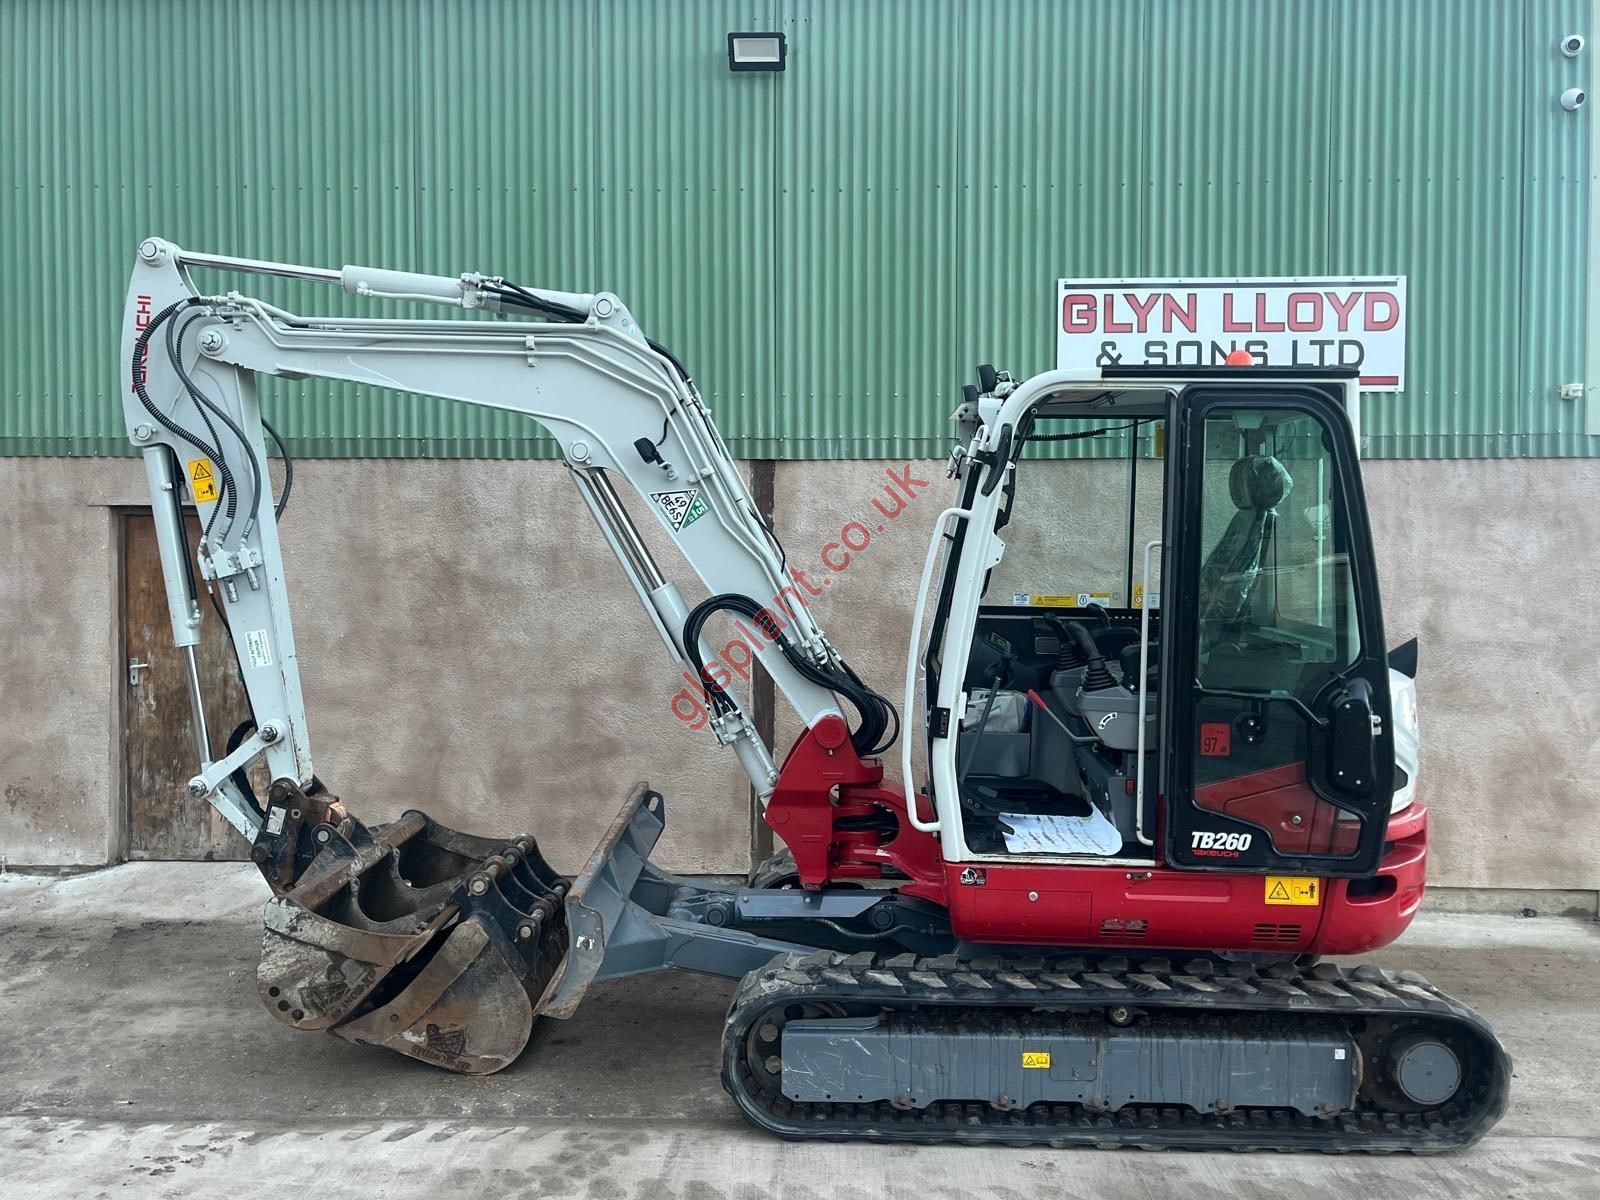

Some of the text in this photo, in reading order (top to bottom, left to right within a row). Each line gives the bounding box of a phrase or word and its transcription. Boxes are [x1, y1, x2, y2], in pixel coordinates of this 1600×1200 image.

[1063, 291, 1400, 333] GLYN LLOYD
[1096, 339, 1365, 367] & SONS LTD
[661, 495, 682, 520] BE6S
[1204, 737, 1217, 752] 97
[1191, 831, 1252, 851] TB260
